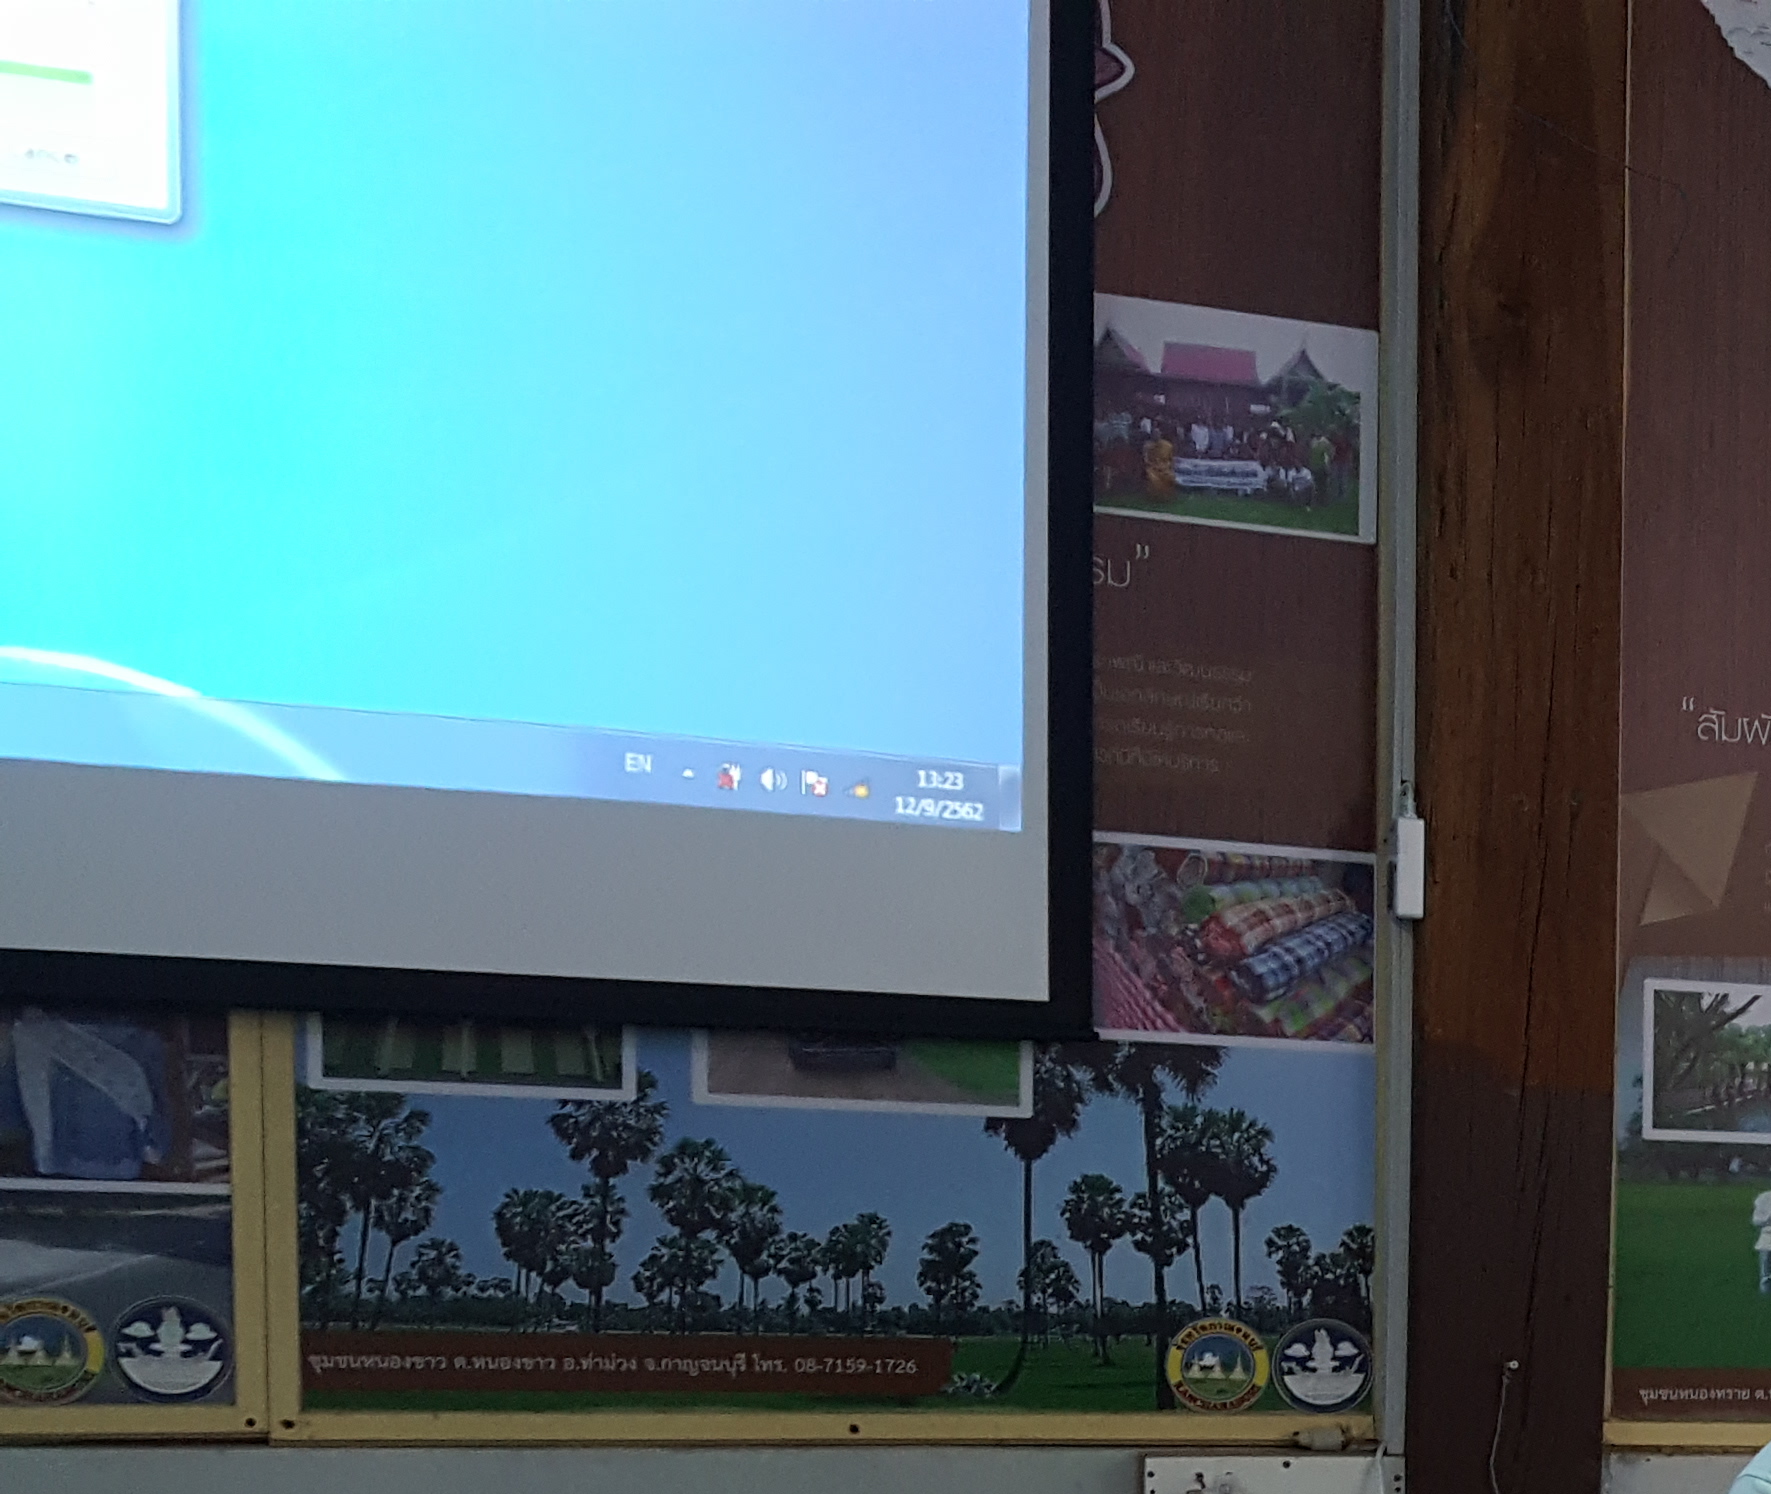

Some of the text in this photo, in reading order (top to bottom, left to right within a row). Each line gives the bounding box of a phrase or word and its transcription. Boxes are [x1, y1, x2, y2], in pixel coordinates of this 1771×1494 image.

[624, 752, 653, 774] EN
[917, 769, 965, 791] 13:23
[895, 795, 984, 821] 12/9/2562
